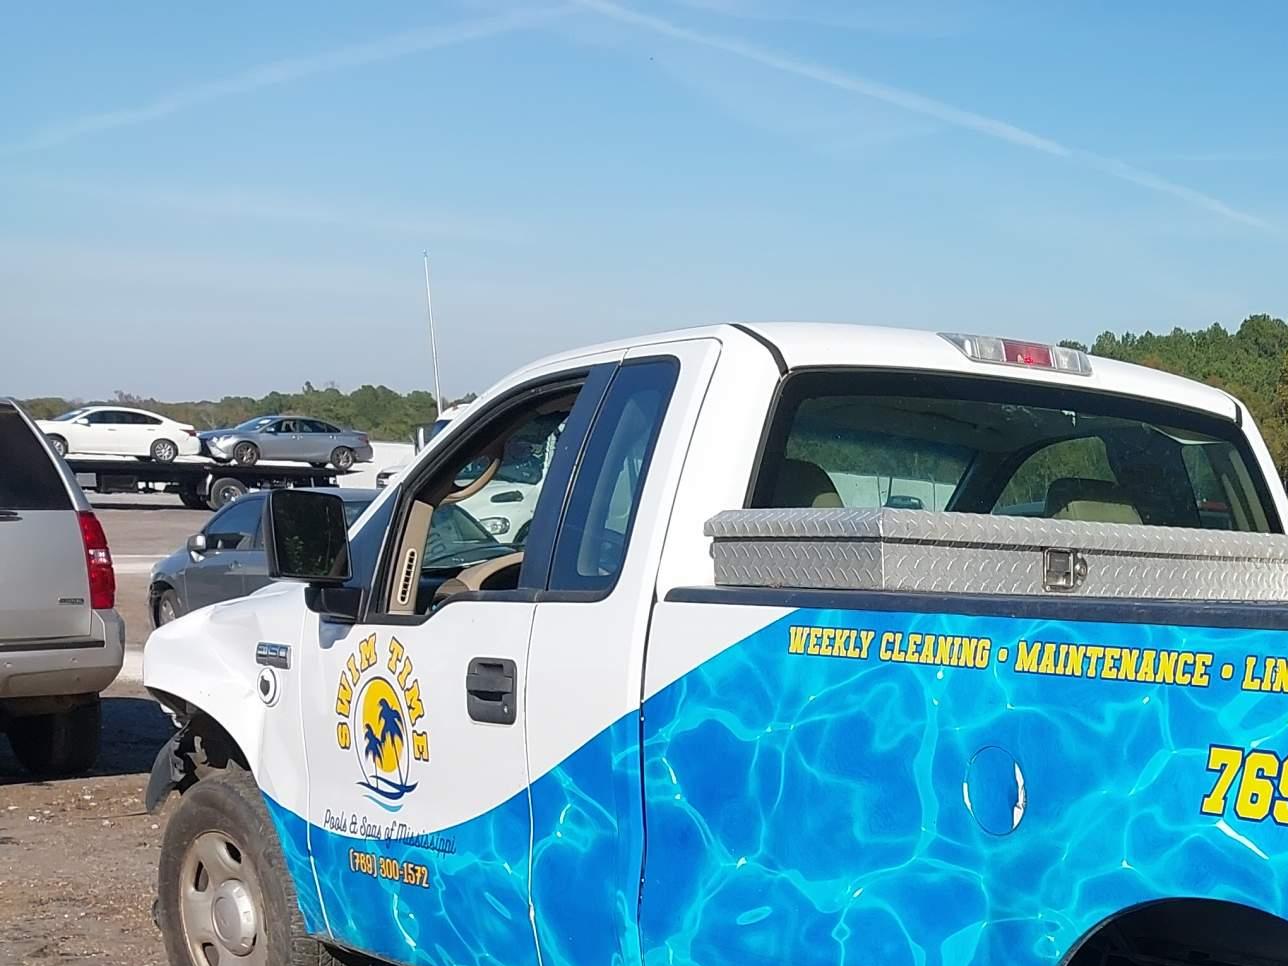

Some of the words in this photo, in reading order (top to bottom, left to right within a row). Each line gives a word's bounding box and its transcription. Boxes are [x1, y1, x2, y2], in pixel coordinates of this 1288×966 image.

[787, 626, 875, 660] WEEKLY
[878, 632, 992, 669] CLEANING
[1013, 641, 1214, 688] MAINTENANCE
[336, 632, 377, 750] SWIM
[387, 636, 430, 762] TIME
[324, 809, 347, 833] Pools
[349, 814, 358, 834] &
[360, 816, 382, 840] Spas
[384, 821, 397, 849] of
[398, 823, 456, 858] Mississippi
[379, 856, 430, 889] 300-1572
